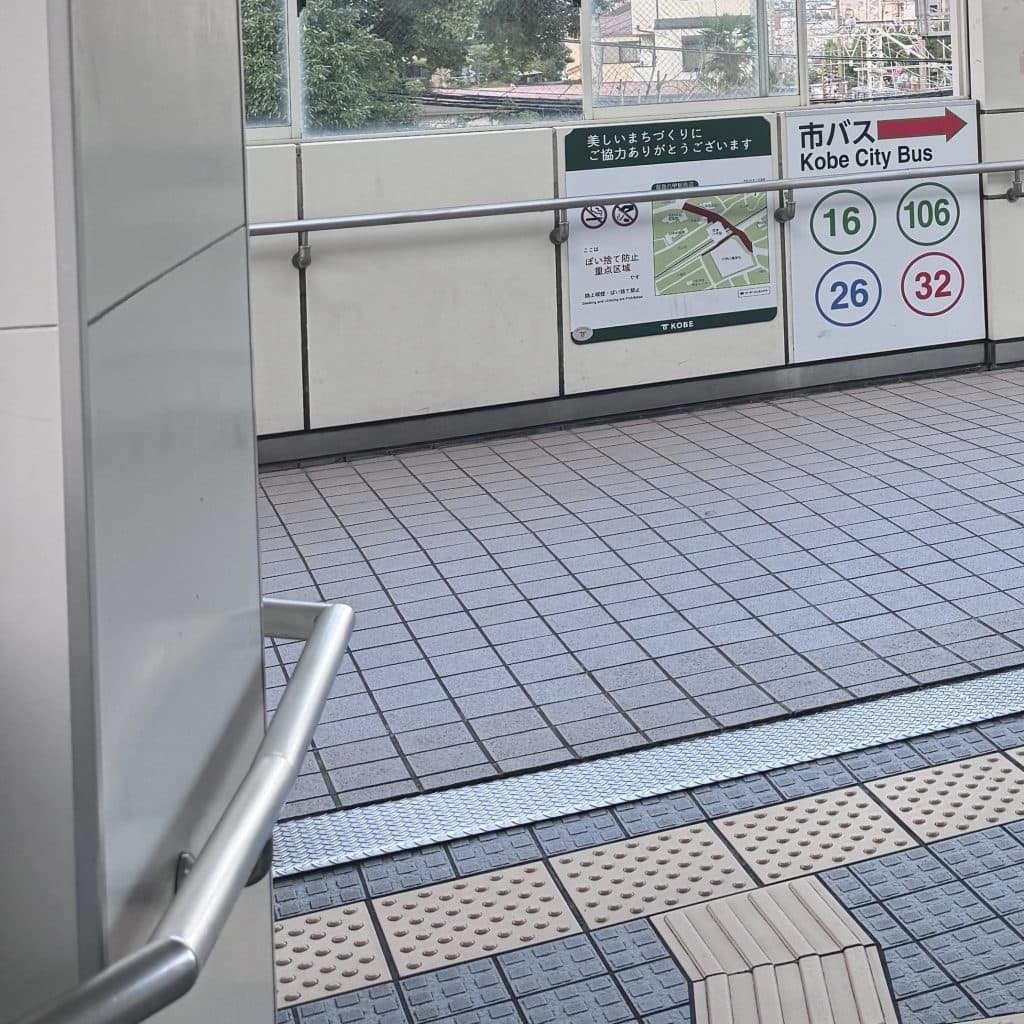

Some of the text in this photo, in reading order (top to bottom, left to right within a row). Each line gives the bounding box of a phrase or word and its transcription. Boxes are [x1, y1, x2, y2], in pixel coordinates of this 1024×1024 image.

[587, 128, 702, 148] 美しいまちづくりに
[799, 119, 875, 150] 市バス
[589, 138, 752, 161] ご協力ありがとうございます
[801, 145, 933, 172] Kobe City Bus
[823, 199, 950, 238] 16 106
[830, 270, 952, 310] 26 32
[670, 320, 695, 330] KOBE
